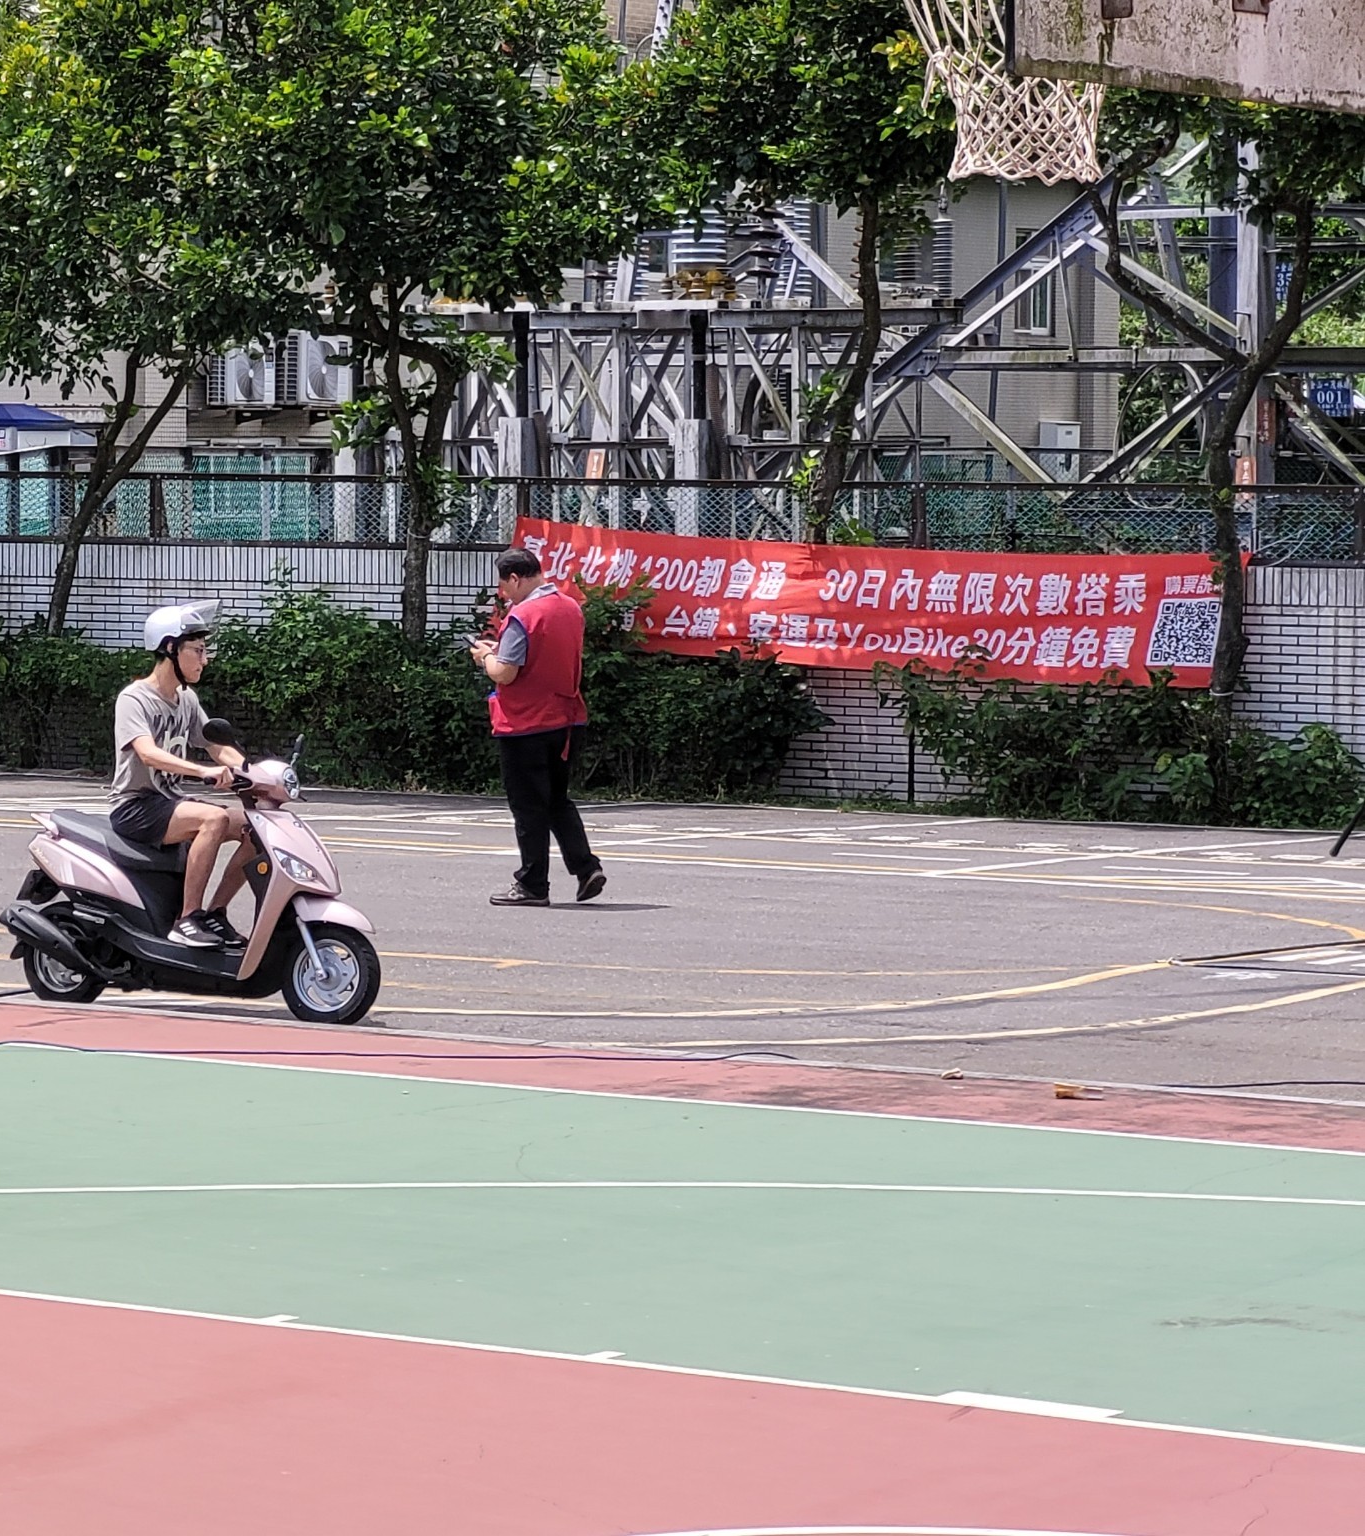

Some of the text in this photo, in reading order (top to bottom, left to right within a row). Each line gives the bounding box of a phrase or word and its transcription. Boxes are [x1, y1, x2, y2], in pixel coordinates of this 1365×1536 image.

[1317, 390, 1342, 404] 001
[819, 568, 1147, 615] 30日內無限次數搭乘
